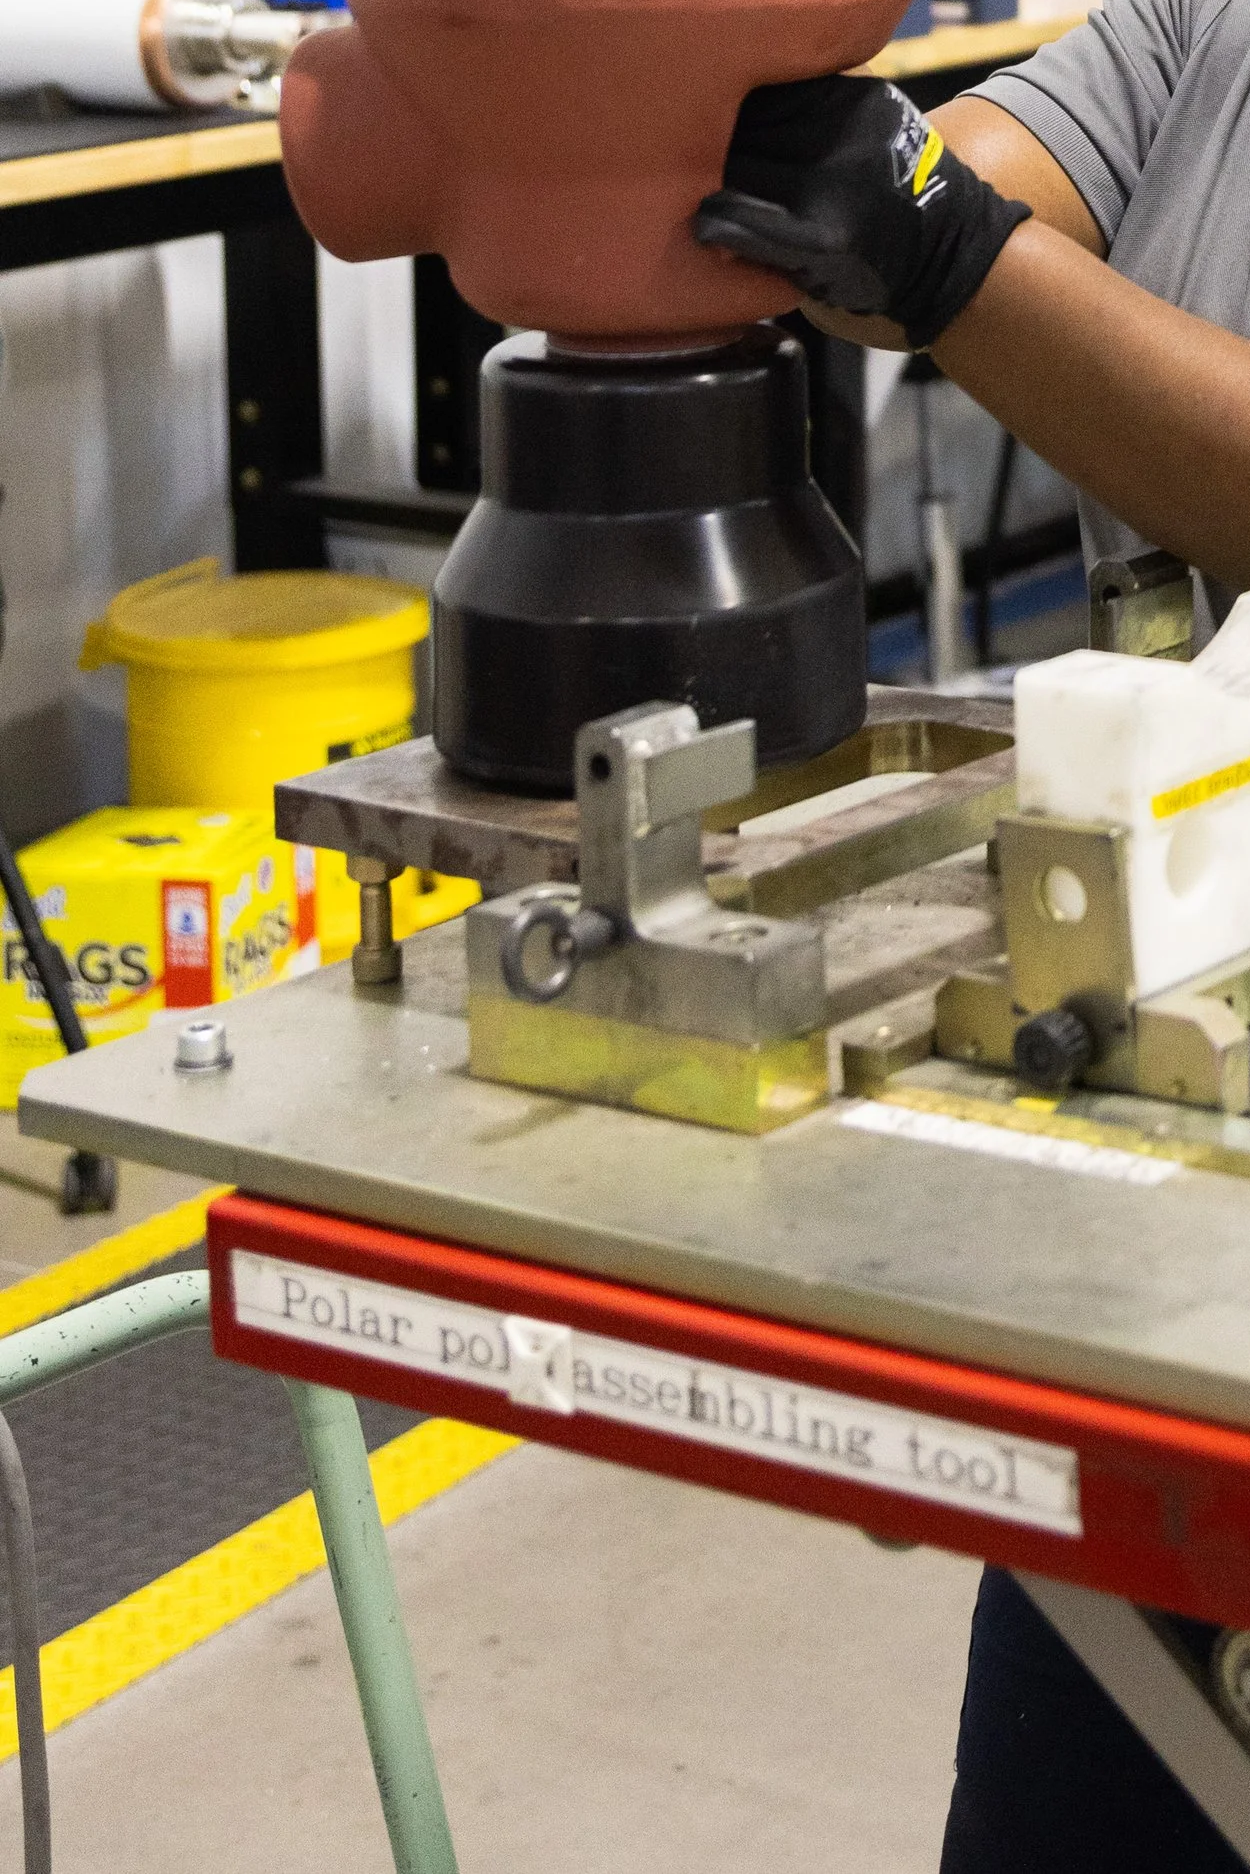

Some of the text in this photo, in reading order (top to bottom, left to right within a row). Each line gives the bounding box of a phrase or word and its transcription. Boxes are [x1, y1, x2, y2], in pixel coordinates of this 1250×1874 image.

[281, 1276, 1022, 1501] Polar pol assembling tool
